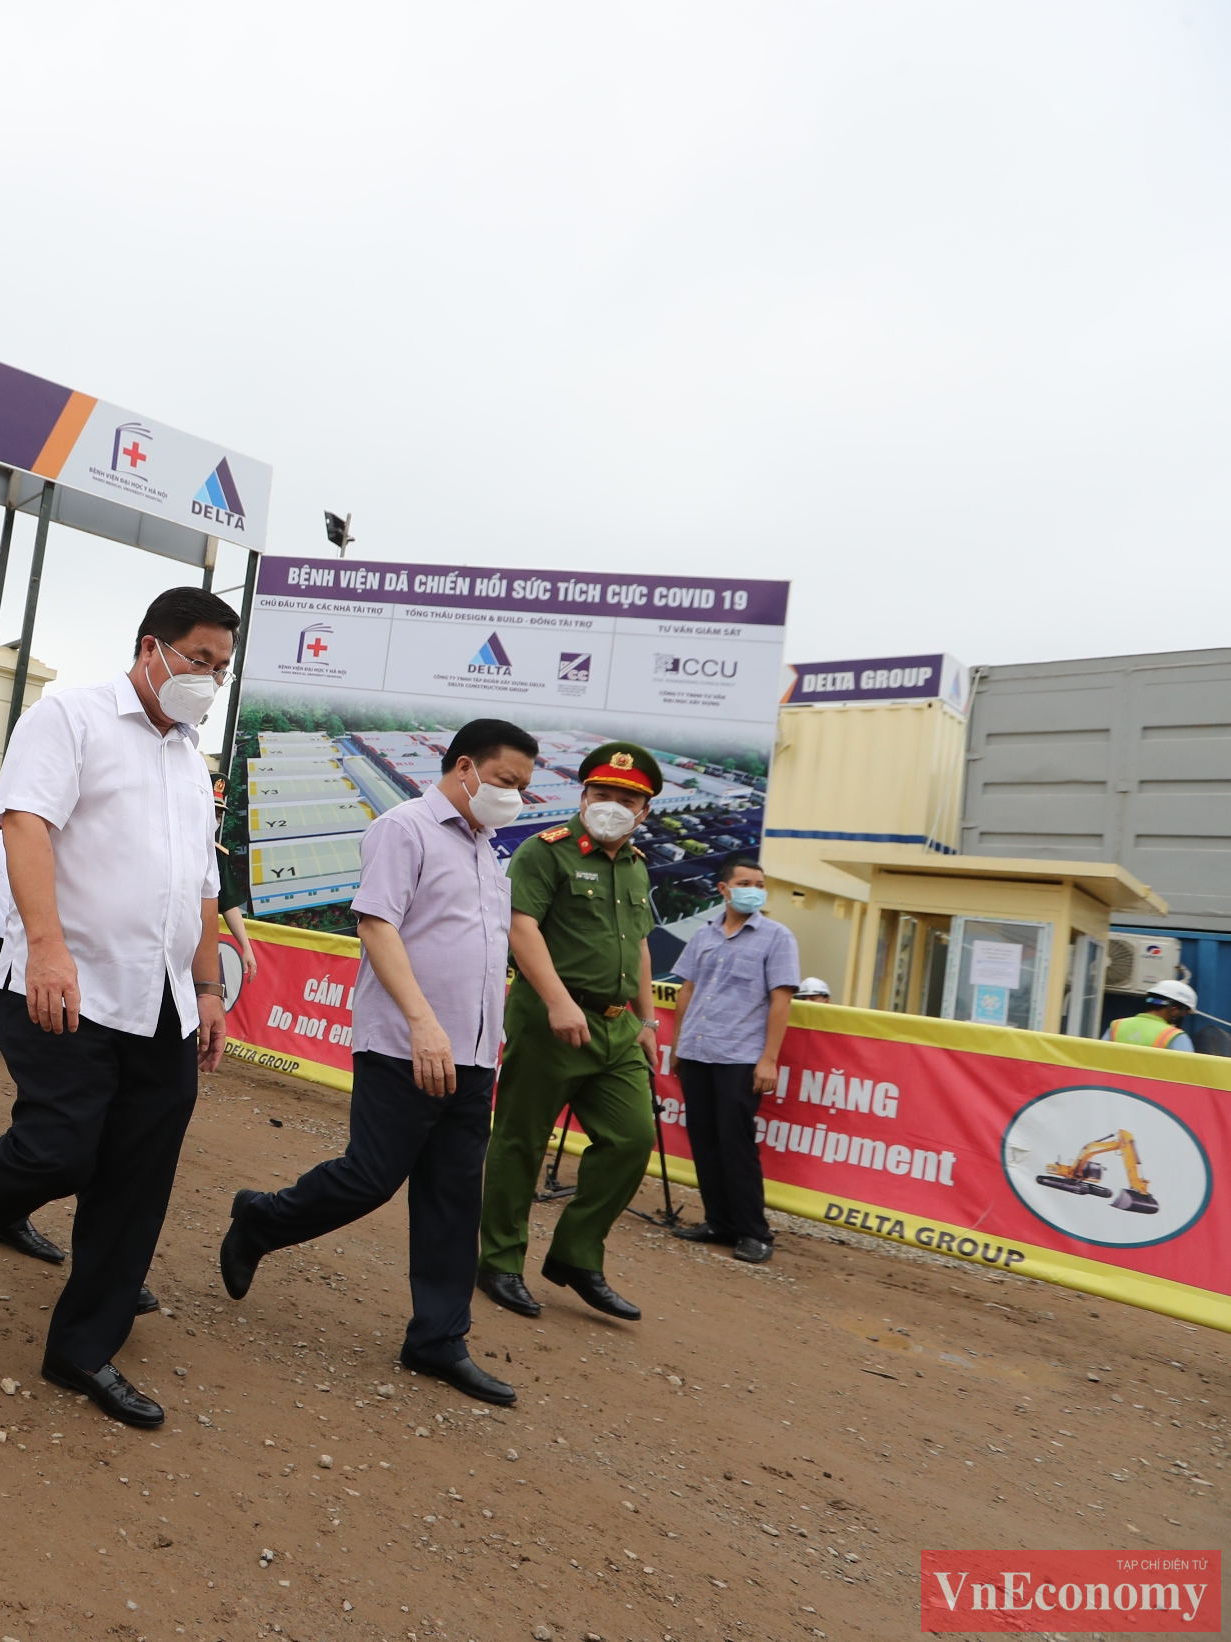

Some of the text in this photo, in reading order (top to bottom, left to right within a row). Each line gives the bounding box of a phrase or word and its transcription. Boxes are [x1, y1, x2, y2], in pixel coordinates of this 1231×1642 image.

[89, 466, 105, 477] BỆNH
[106, 473, 119, 482] VIỆN
[120, 477, 130, 486] ĐẠI
[131, 481, 143, 490] HỌC
[148, 487, 157, 495] HÀ
[157, 490, 168, 499] NỘI
[106, 480, 123, 489] MEDICAL
[145, 494, 163, 503] HOSPITAL
[191, 499, 246, 532] DELTA
[288, 566, 748, 611] BỆNH VIỆN DÃ CHIẾN HỒI SỨC TÍCH CỰC COVID 19
[260, 599, 277, 607] CHỦ
[296, 601, 308, 609] TƯ
[316, 602, 332, 611] CÁC
[333, 604, 351, 612] NHÀ
[352, 605, 366, 614] TÀI
[367, 606, 383, 616] TRỢ
[455, 613, 487, 622] DESIGN
[496, 616, 524, 624] BUILD
[558, 619, 573, 627] TÀI
[574, 620, 593, 629] TRỢ
[695, 626, 722, 635] GIÁM
[724, 627, 742, 636] SÁT
[468, 664, 512, 676] DELTA
[802, 666, 933, 693] DELTA GROUP
[465, 683, 508, 691] CONSTRUCTION
[265, 820, 288, 828] Y2
[270, 866, 296, 878] Y1
[303, 974, 344, 1008] CẤM
[267, 1004, 292, 1031] Do
[294, 1015, 327, 1040] not
[224, 1041, 300, 1074] DELTA GROUP
[799, 1068, 899, 1119] NẶNG
[824, 1202, 1026, 1268] DELTA GROUP
